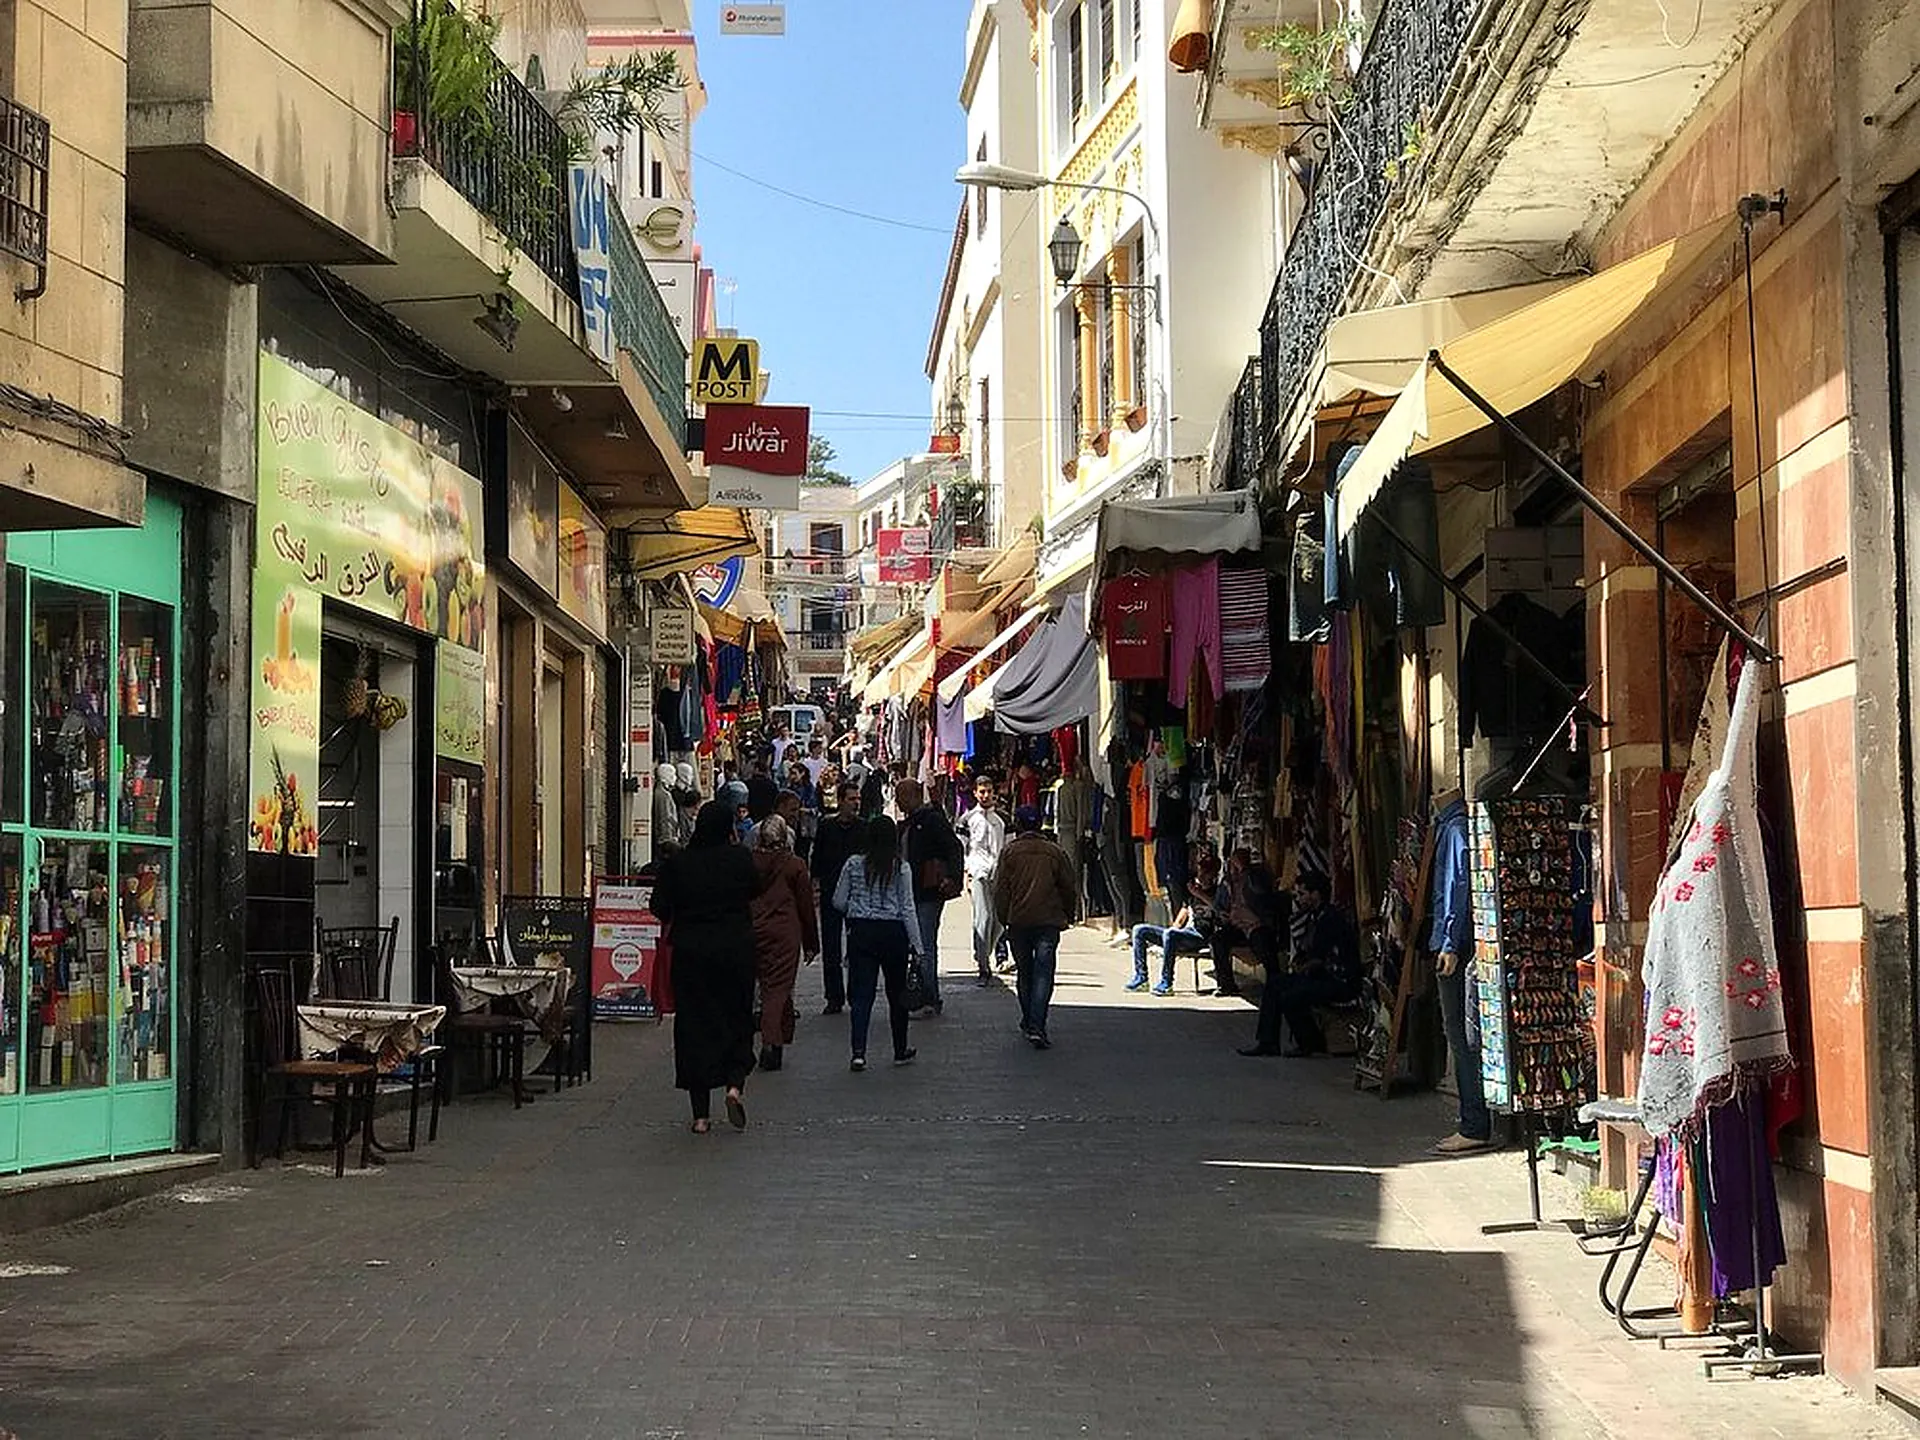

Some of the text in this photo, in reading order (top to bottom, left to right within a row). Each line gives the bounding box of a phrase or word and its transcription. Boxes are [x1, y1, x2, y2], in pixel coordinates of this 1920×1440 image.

[698, 343, 751, 380] M
[696, 381, 751, 398] POST
[722, 433, 789, 452] Jiwar
